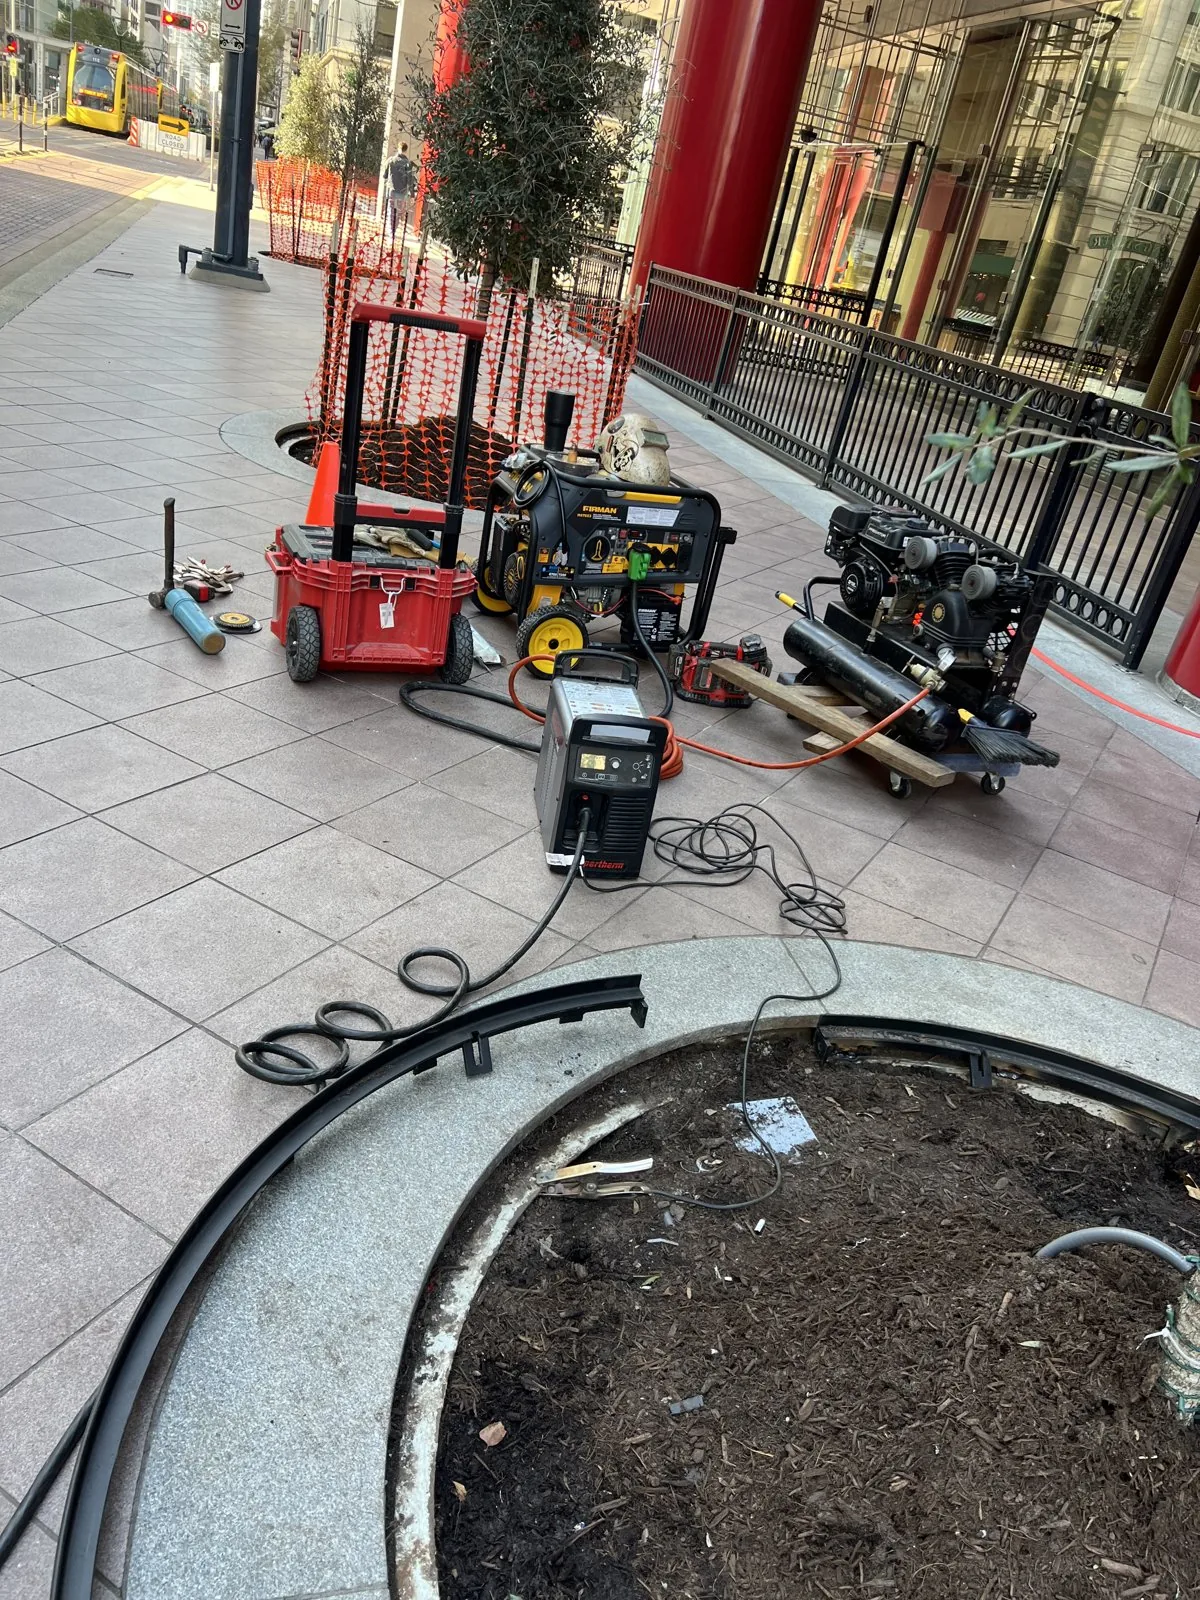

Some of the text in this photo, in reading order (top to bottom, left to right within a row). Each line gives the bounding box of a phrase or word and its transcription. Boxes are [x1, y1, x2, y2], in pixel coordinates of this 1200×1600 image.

[165, 134, 182, 142] ROAD
[161, 139, 185, 149] CLOSED
[582, 505, 618, 514] FIRMAN
[582, 860, 625, 869] pertherm
